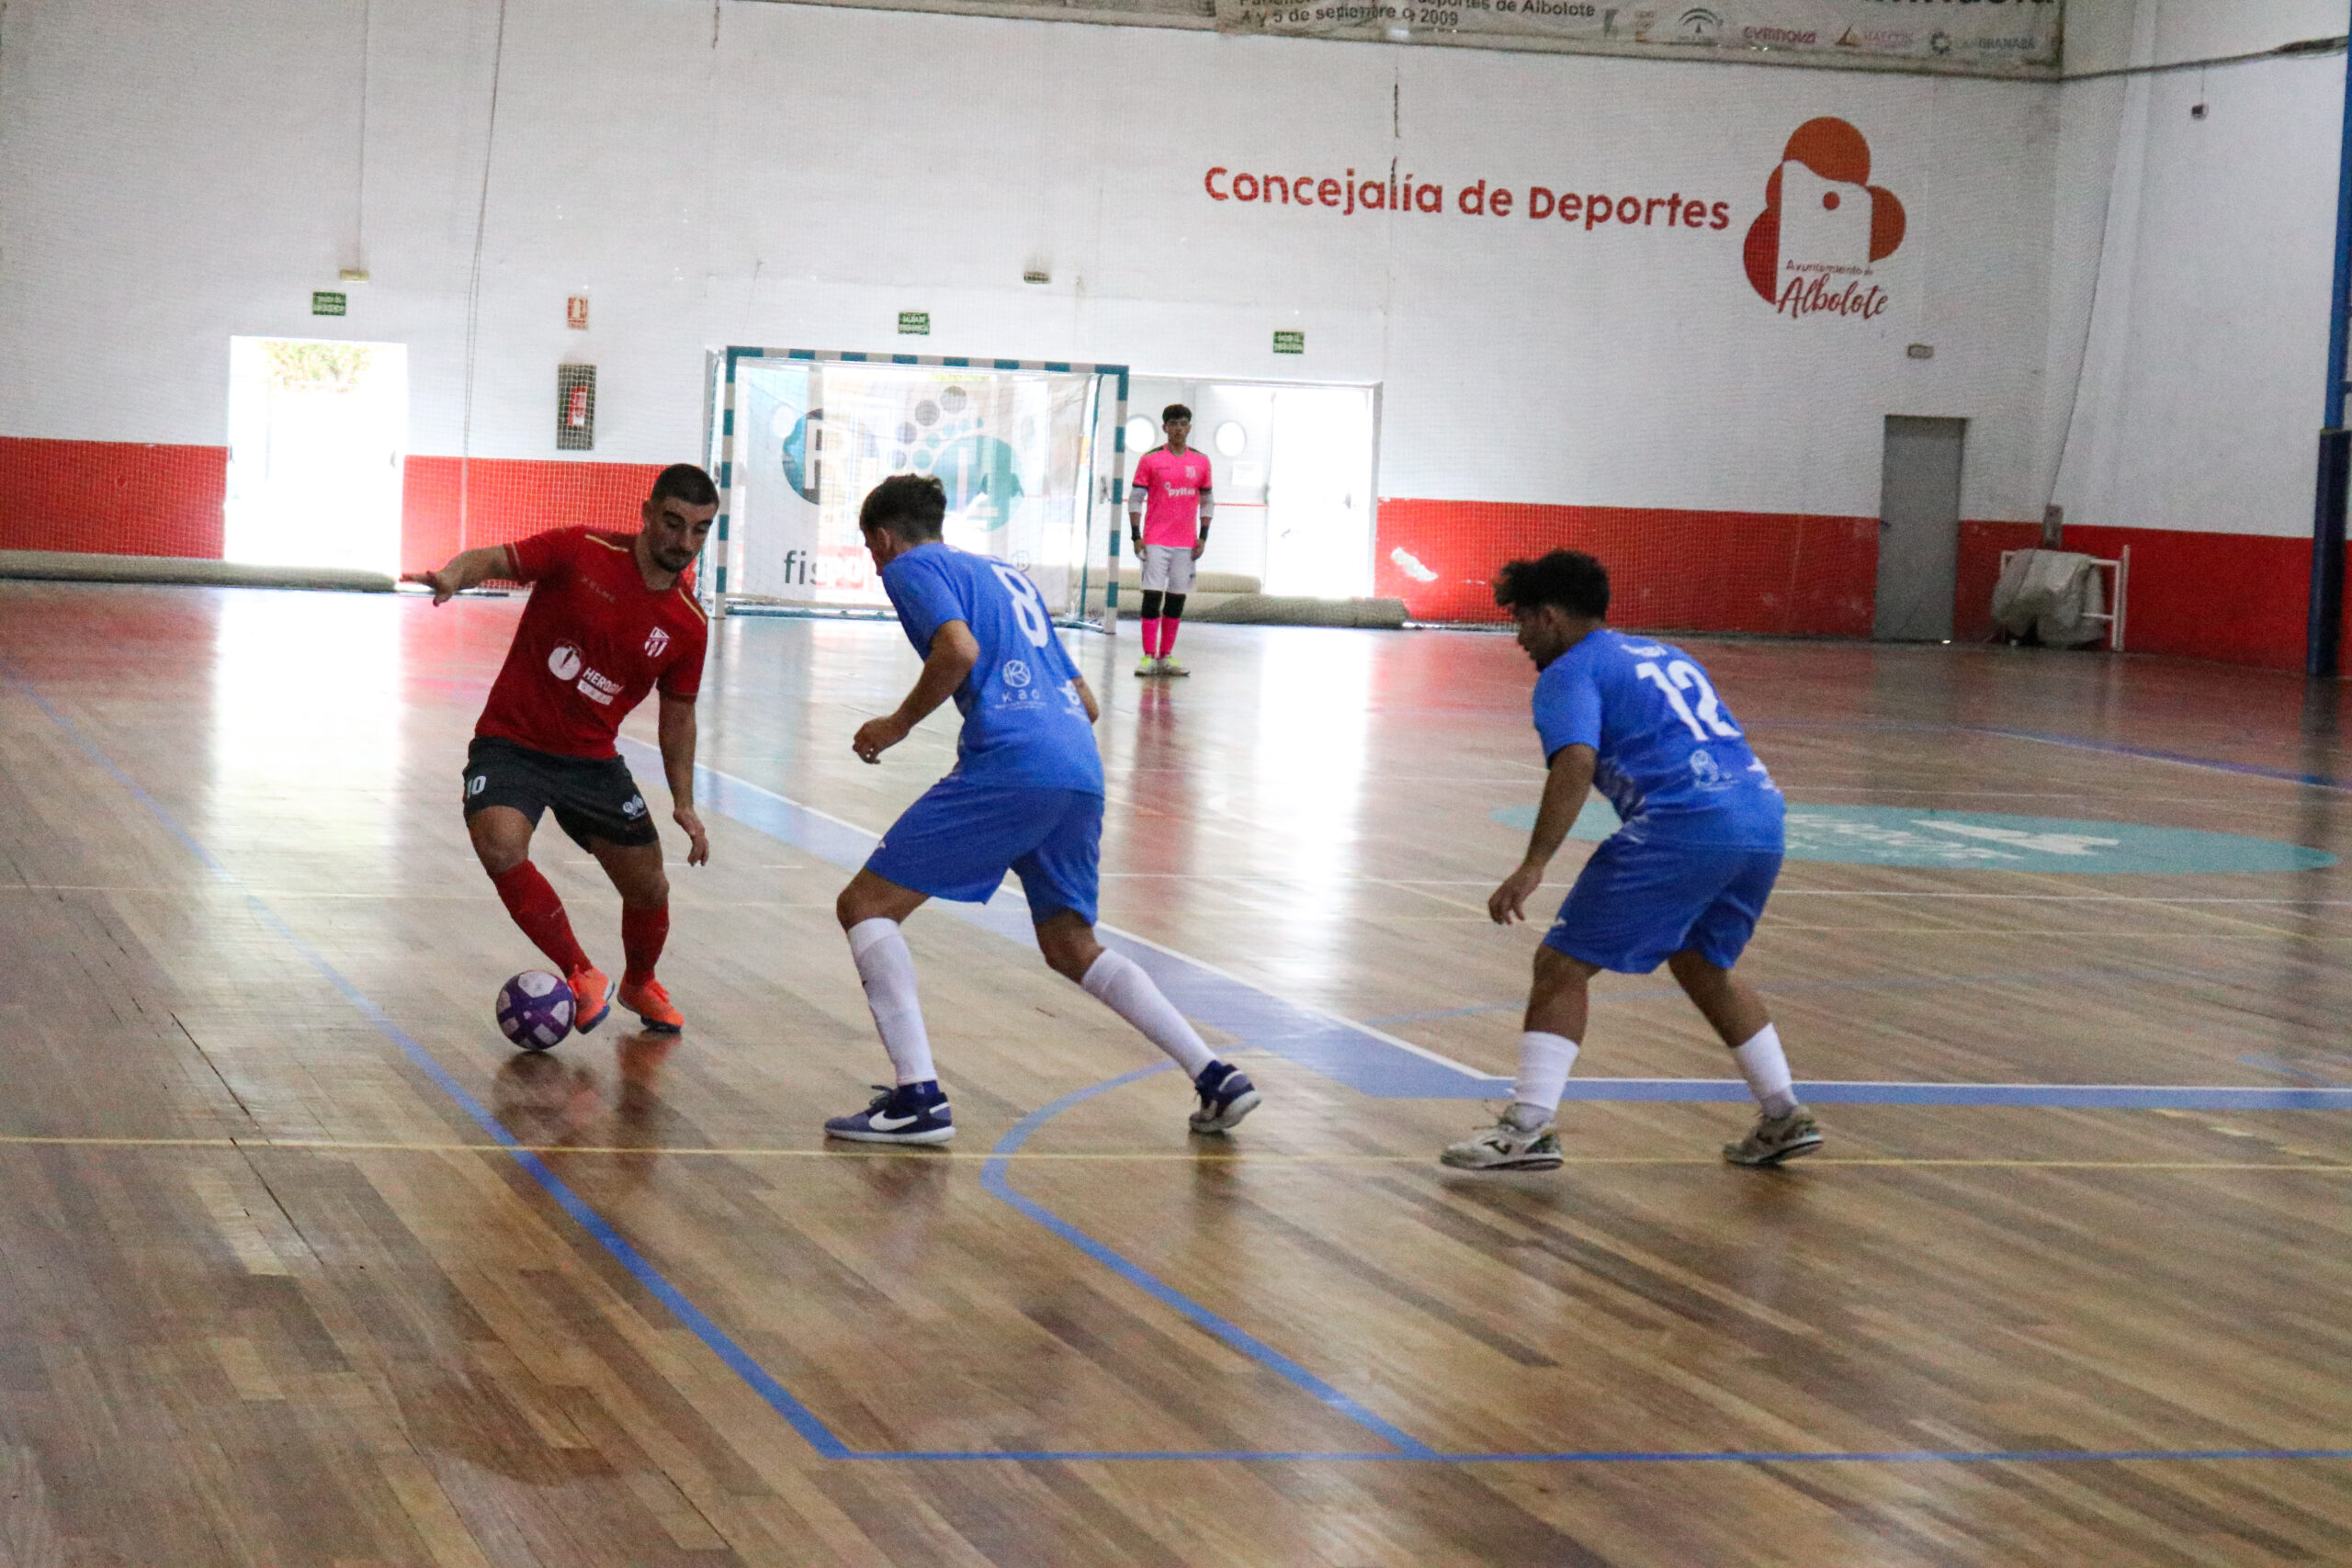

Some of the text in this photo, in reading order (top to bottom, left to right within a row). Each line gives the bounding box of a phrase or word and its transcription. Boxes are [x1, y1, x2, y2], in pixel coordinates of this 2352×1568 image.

[1288, 7, 1310, 22] de
[1420, 8, 1459, 26] 2009
[1522, 0, 1596, 17] Albolote
[1204, 167, 1730, 231] Concejalía de Deportes
[1785, 260, 1863, 276] Ayuntamiento
[1777, 273, 1889, 320] Albolote
[991, 562, 1049, 649] 8
[1635, 660, 1745, 741] 12
